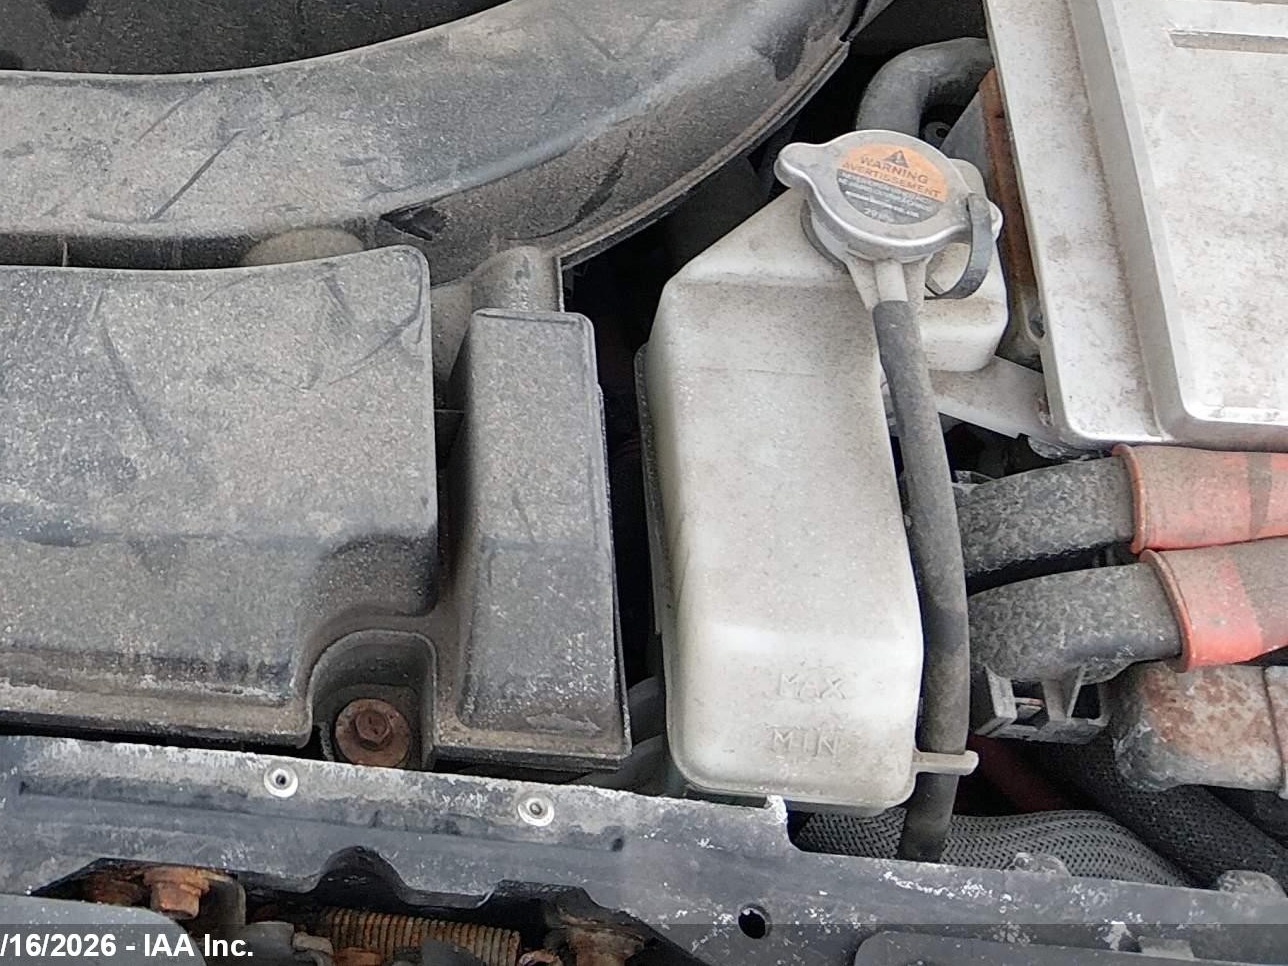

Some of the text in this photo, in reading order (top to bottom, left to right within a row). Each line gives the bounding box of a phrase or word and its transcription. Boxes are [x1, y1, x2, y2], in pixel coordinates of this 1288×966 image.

[842, 161, 942, 198] AVERTISSEMENT
[860, 153, 929, 184] WARNING
[776, 671, 847, 700] MAX
[770, 725, 841, 755] MIN
